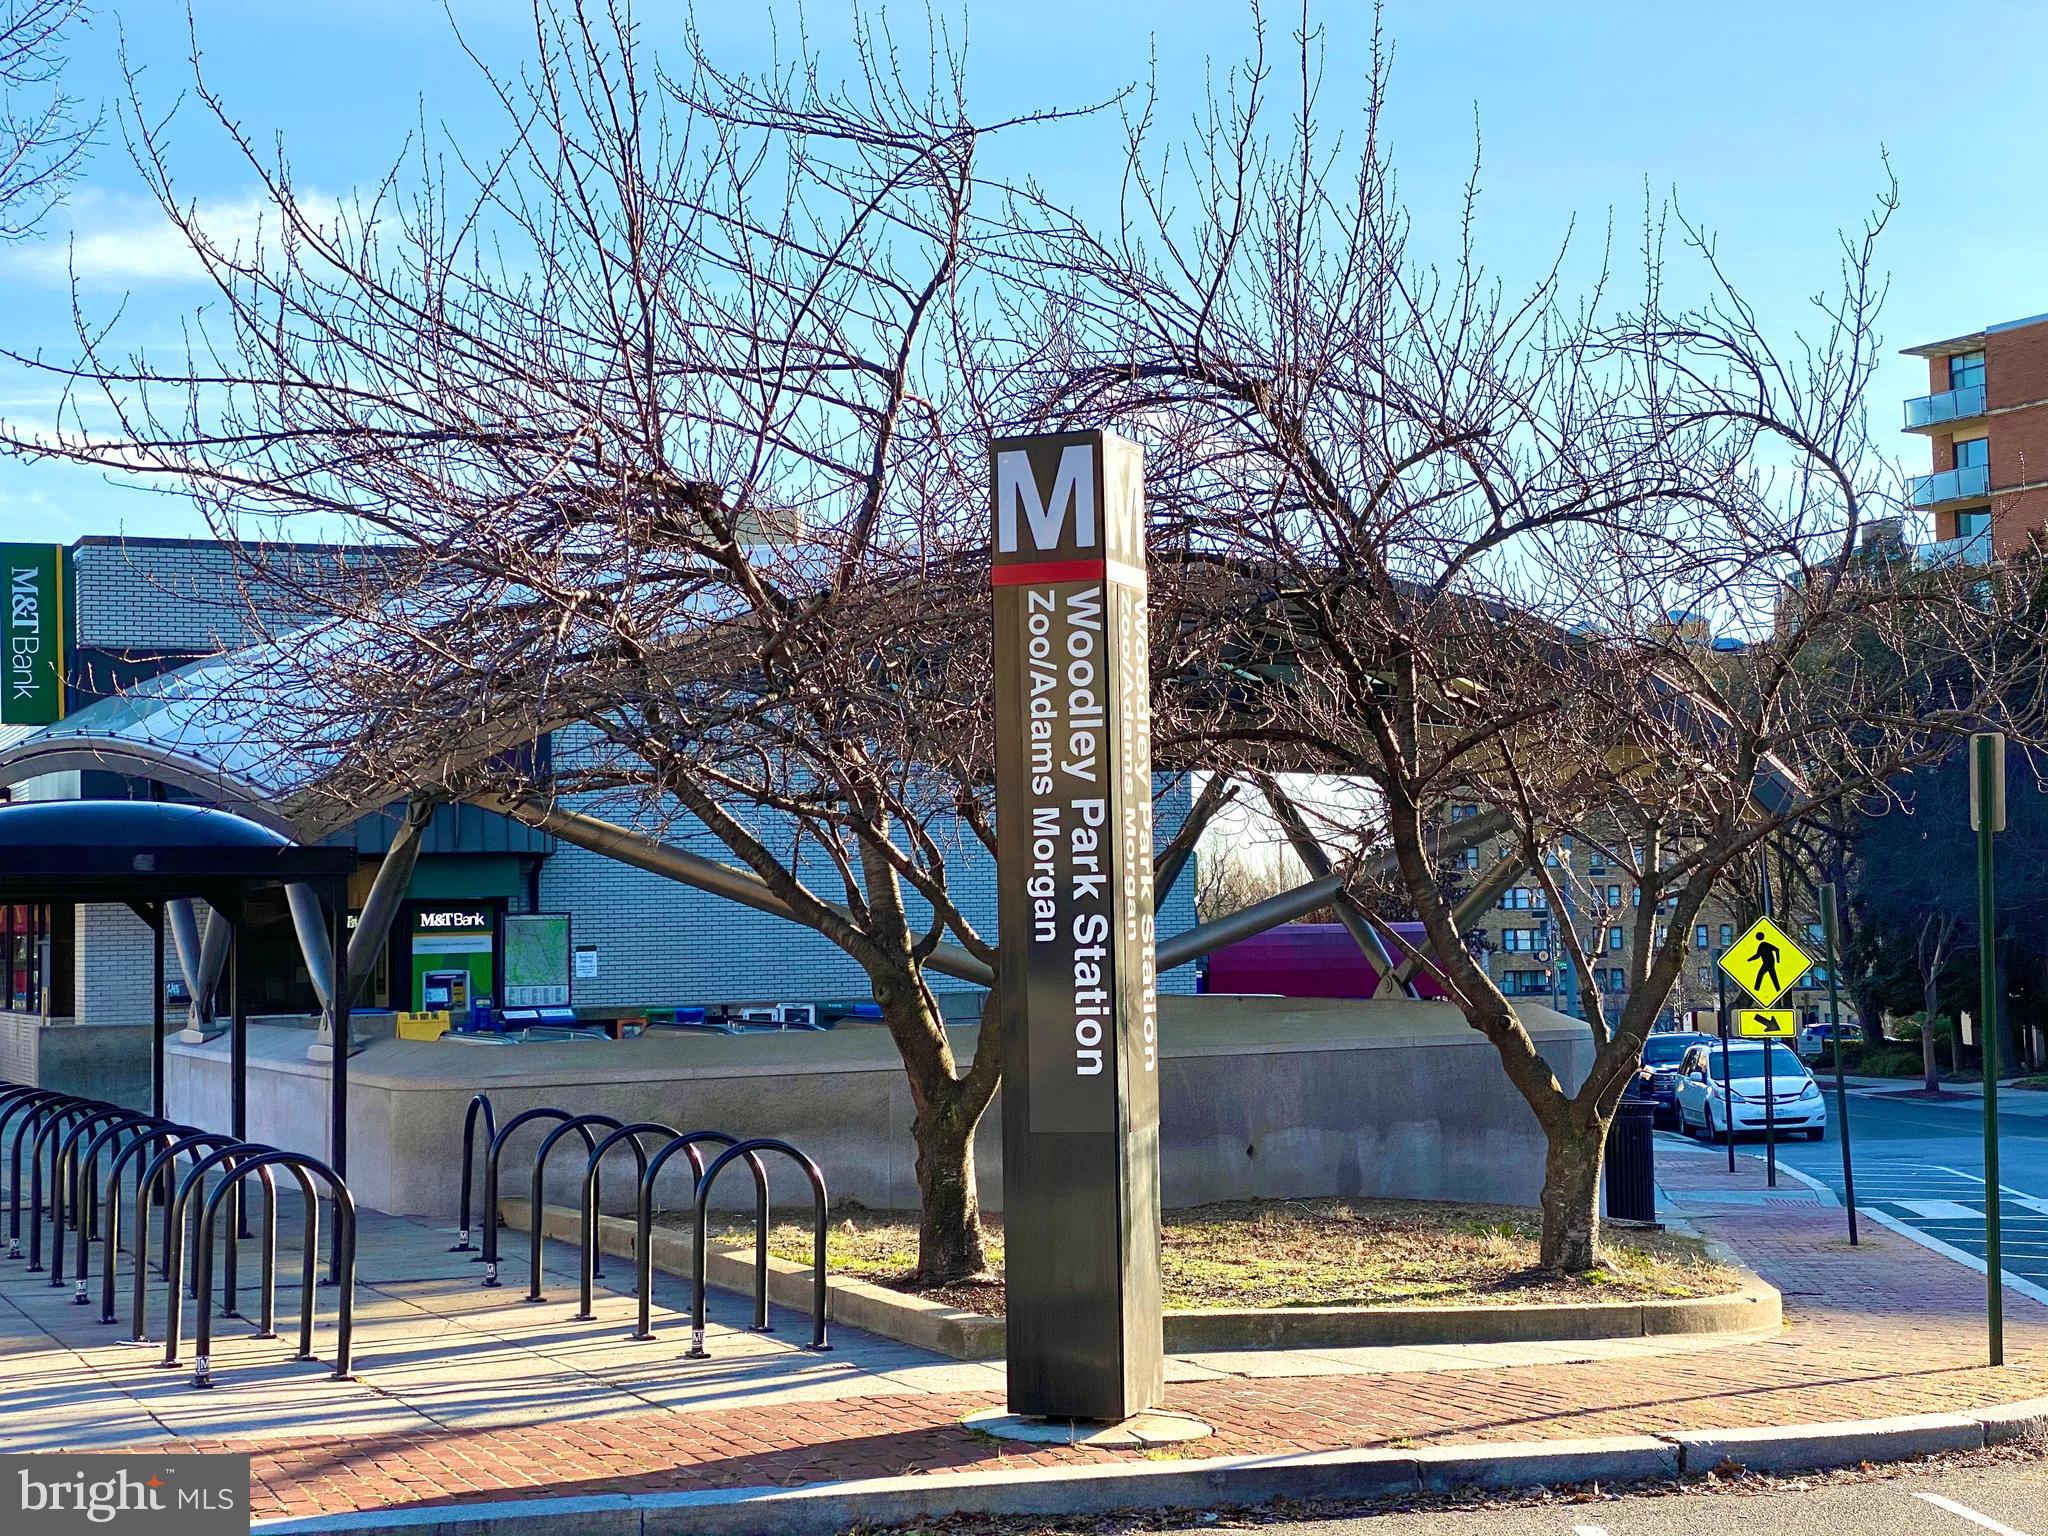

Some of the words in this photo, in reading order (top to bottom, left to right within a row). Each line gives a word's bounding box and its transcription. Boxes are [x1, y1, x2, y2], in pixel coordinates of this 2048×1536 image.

[997, 444, 1095, 553] M
[1105, 446, 1144, 561] M
[11, 566, 39, 634] M&T
[12, 637, 40, 700] Bank
[1028, 590, 1058, 795] Zoo/Adams
[1061, 586, 1104, 782] Woodley
[1121, 590, 1134, 796] Zoo/Adams
[1134, 596, 1151, 786] Woodley
[1026, 807, 1061, 942] Morgan
[1071, 798, 1107, 900] Park
[1124, 807, 1137, 941] Morgan
[1138, 801, 1154, 899] Park
[420, 913, 453, 927] M&T
[453, 912, 485, 926] Bank
[1073, 914, 1110, 1076] Station
[1140, 913, 1157, 1072] Station
